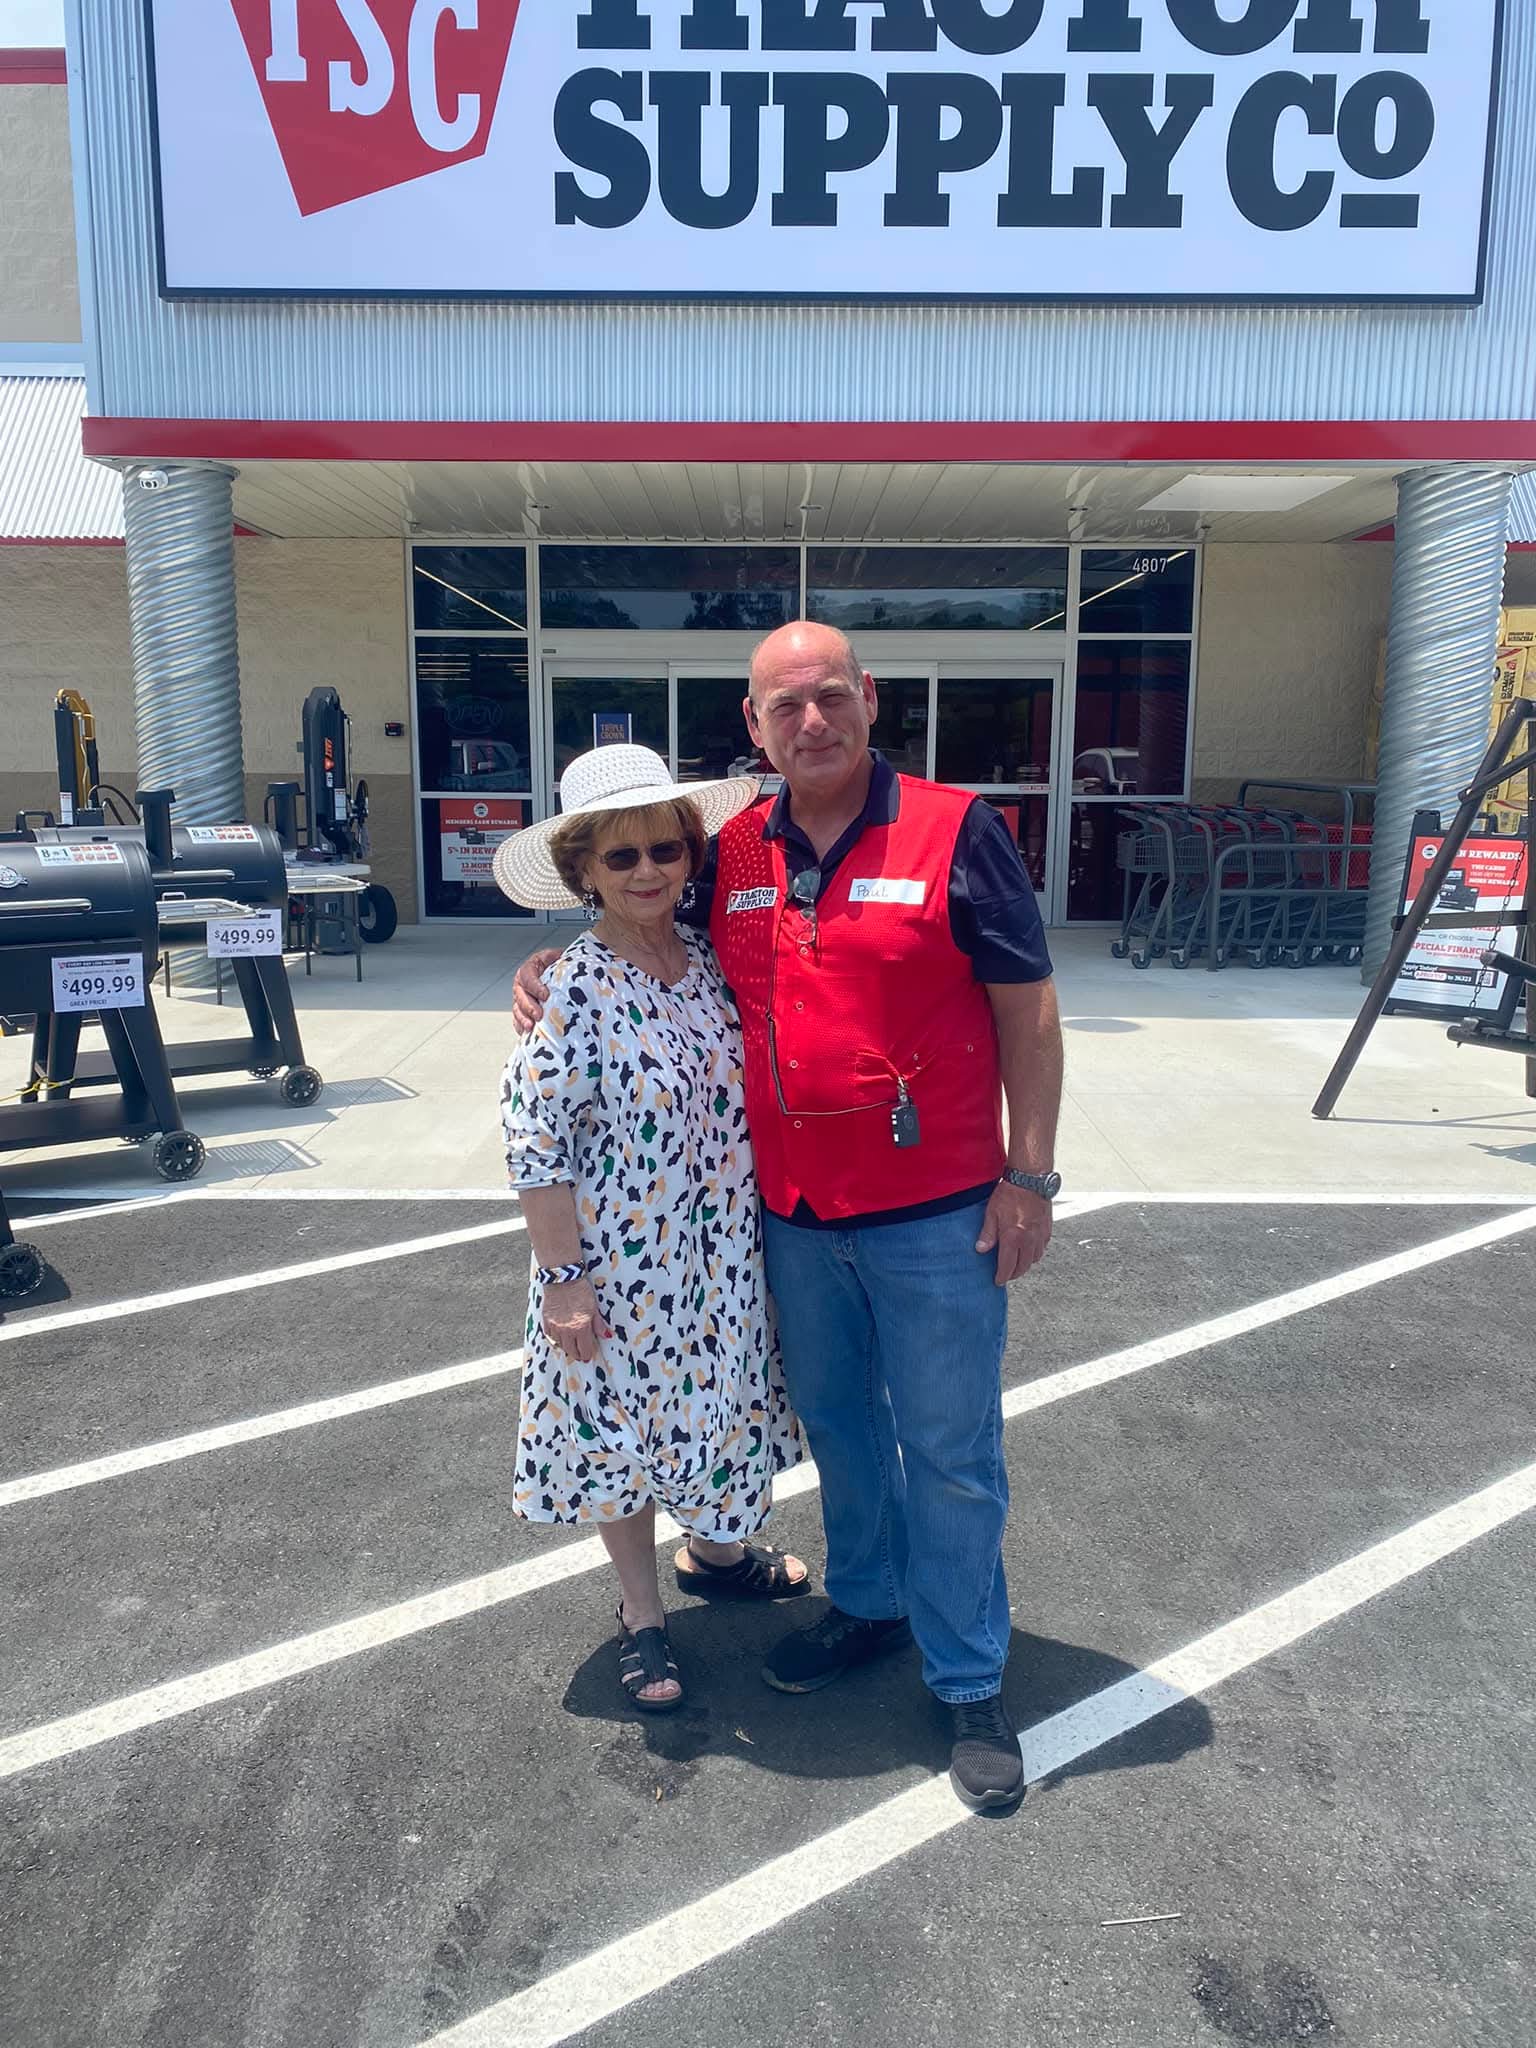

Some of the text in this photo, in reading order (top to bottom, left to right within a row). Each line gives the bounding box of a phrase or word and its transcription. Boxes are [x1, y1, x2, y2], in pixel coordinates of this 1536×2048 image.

[553, 67, 1215, 230] SUPPLY
[1132, 557, 1167, 573] 4807
[472, 846, 498, 855] REWA
[1468, 849, 1522, 860] REWARDS
[740, 889, 775, 900] TRACTOR
[735, 897, 763, 909] SUPPLY
[214, 928, 275, 945] $499.99
[1447, 945, 1487, 956] FINANCI
[62, 975, 136, 996] $499.99
